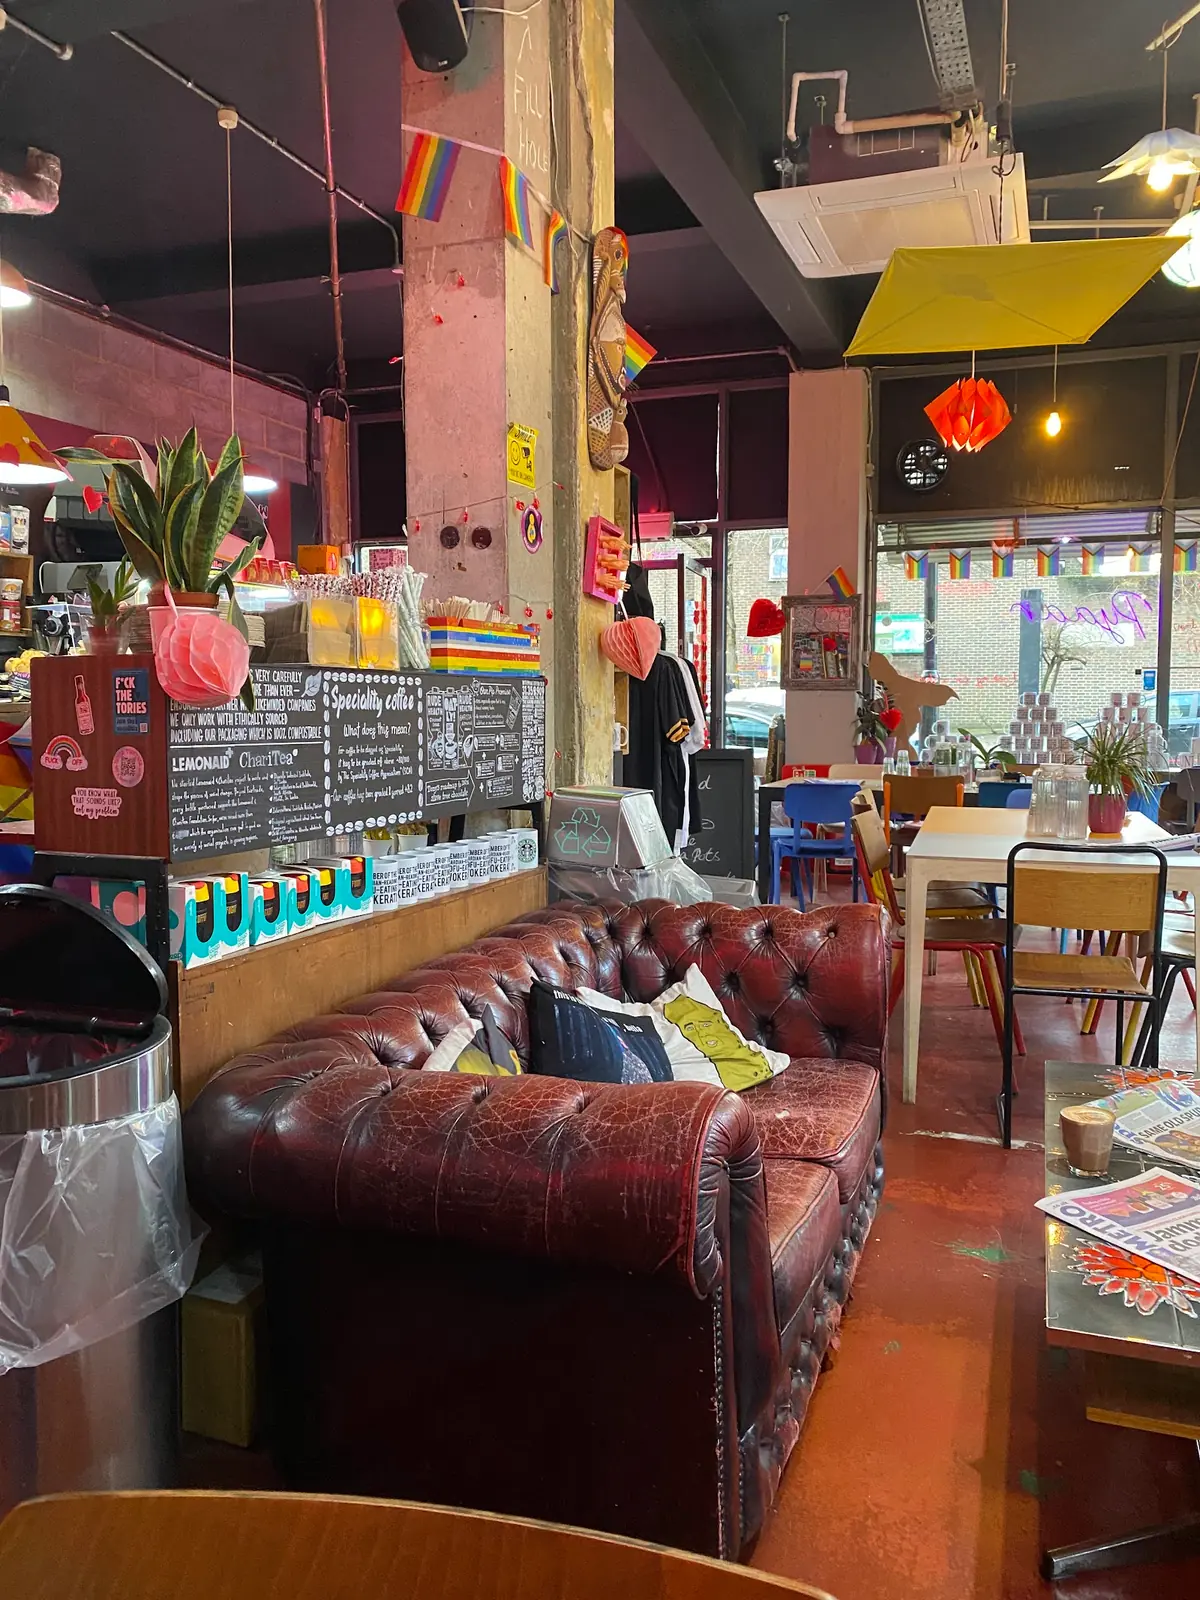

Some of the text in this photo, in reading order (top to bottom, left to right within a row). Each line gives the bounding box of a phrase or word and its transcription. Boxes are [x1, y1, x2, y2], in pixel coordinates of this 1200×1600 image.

[514, 67, 543, 119] FILL
[518, 121, 549, 173] HOLE
[255, 669, 270, 682] VERY
[272, 670, 303, 683] CAREFULLY
[115, 689, 133, 702] THE
[263, 684, 279, 697] THAN
[385, 686, 415, 711] coffee
[115, 701, 148, 715] TORIES
[287, 699, 317, 712] COMPANIES
[169, 711, 288, 727] WE ONLY WORK WITH ETHICALLY SOURCED
[169, 728, 204, 743] INCLUDING
[204, 728, 217, 741] OUR
[217, 727, 248, 741] PACKAGING
[248, 727, 266, 740] WHICH
[266, 727, 272, 739] IS
[287, 726, 322, 739] COMPOSTABLE
[343, 721, 361, 739] What
[391, 721, 411, 736] mean?
[172, 751, 294, 772] LEMONAID ChariTea
[1138, 1122, 1168, 1139] SAME
[1163, 1116, 1185, 1129] OLD
[1059, 1205, 1157, 1251] METRO
